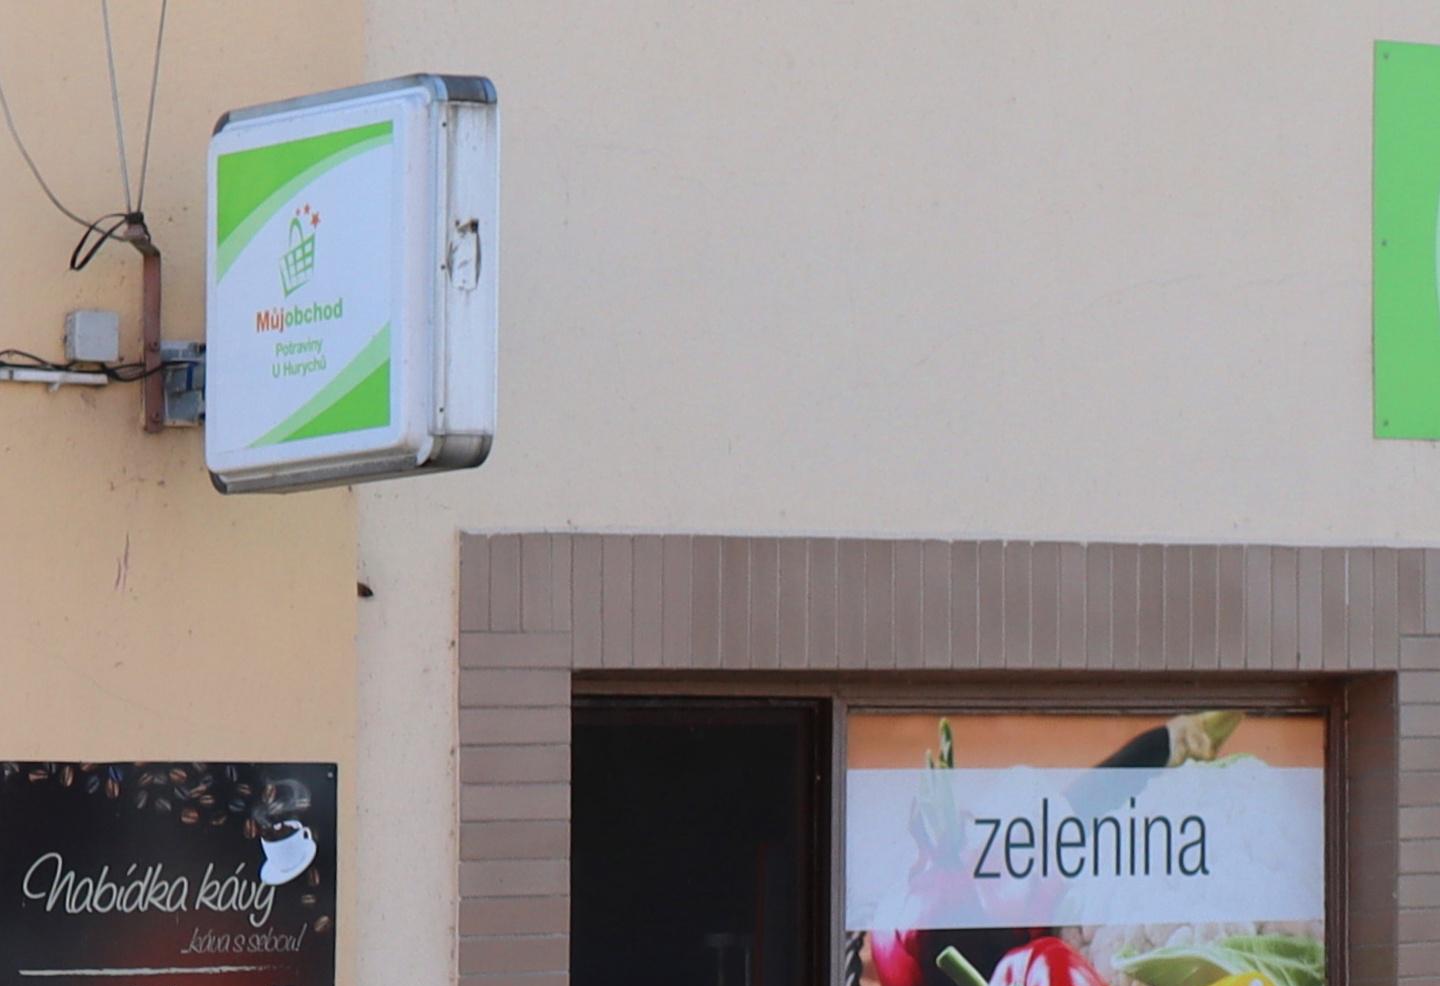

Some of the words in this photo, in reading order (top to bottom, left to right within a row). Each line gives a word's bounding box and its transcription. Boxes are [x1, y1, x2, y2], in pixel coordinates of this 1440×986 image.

[256, 297, 343, 333] Můjobchod
[275, 338, 323, 357] Potraviny
[272, 363, 281, 378] U
[972, 797, 1210, 880] zelenina
[23, 853, 188, 912] Nabídka
[195, 862, 275, 927] kávy
